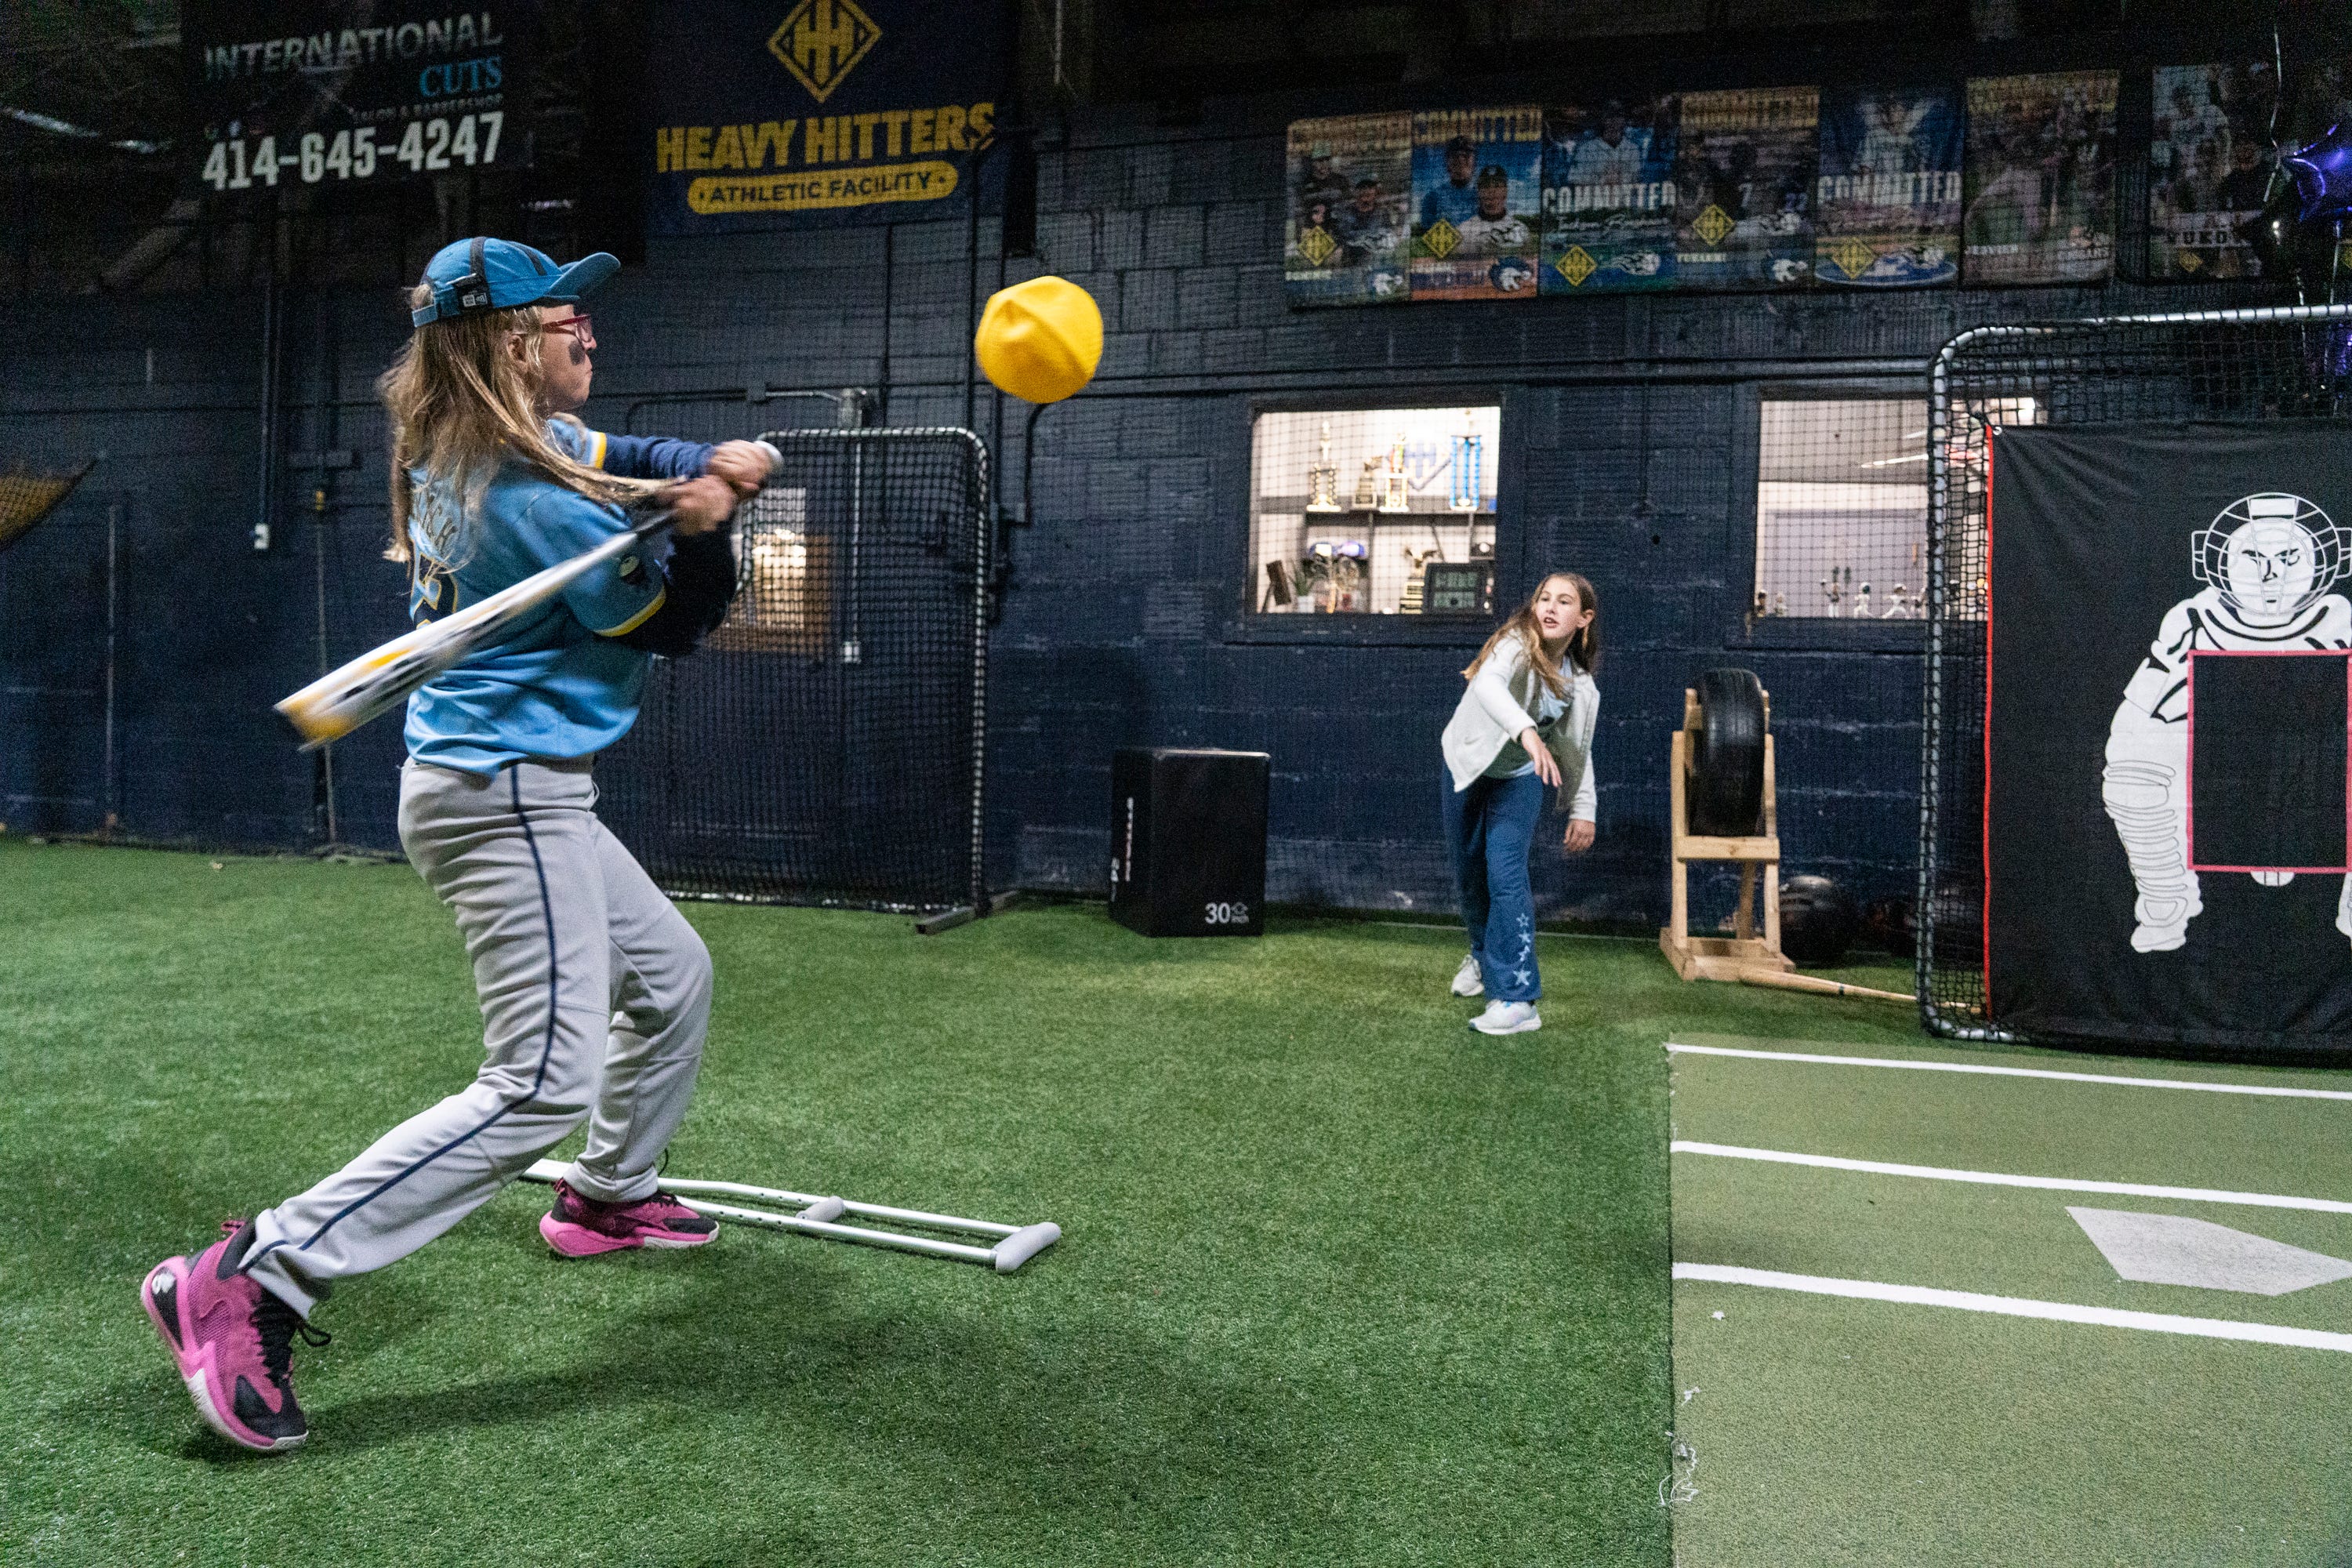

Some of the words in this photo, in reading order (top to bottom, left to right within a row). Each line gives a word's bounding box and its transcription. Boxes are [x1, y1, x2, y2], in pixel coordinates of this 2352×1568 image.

[204, 13, 503, 80] INTERNATIONAL
[419, 56, 503, 99] CUTS
[202, 111, 504, 191] 414-645-4247
[656, 119, 797, 173] HEAVY
[805, 102, 996, 165] HITTERS
[710, 182, 822, 203] ATHLETIC
[829, 172, 931, 197] FACILITY
[1543, 181, 1677, 212] COMMITTED
[1817, 170, 1962, 205] COMMITTED
[1204, 902, 1230, 925] 30
